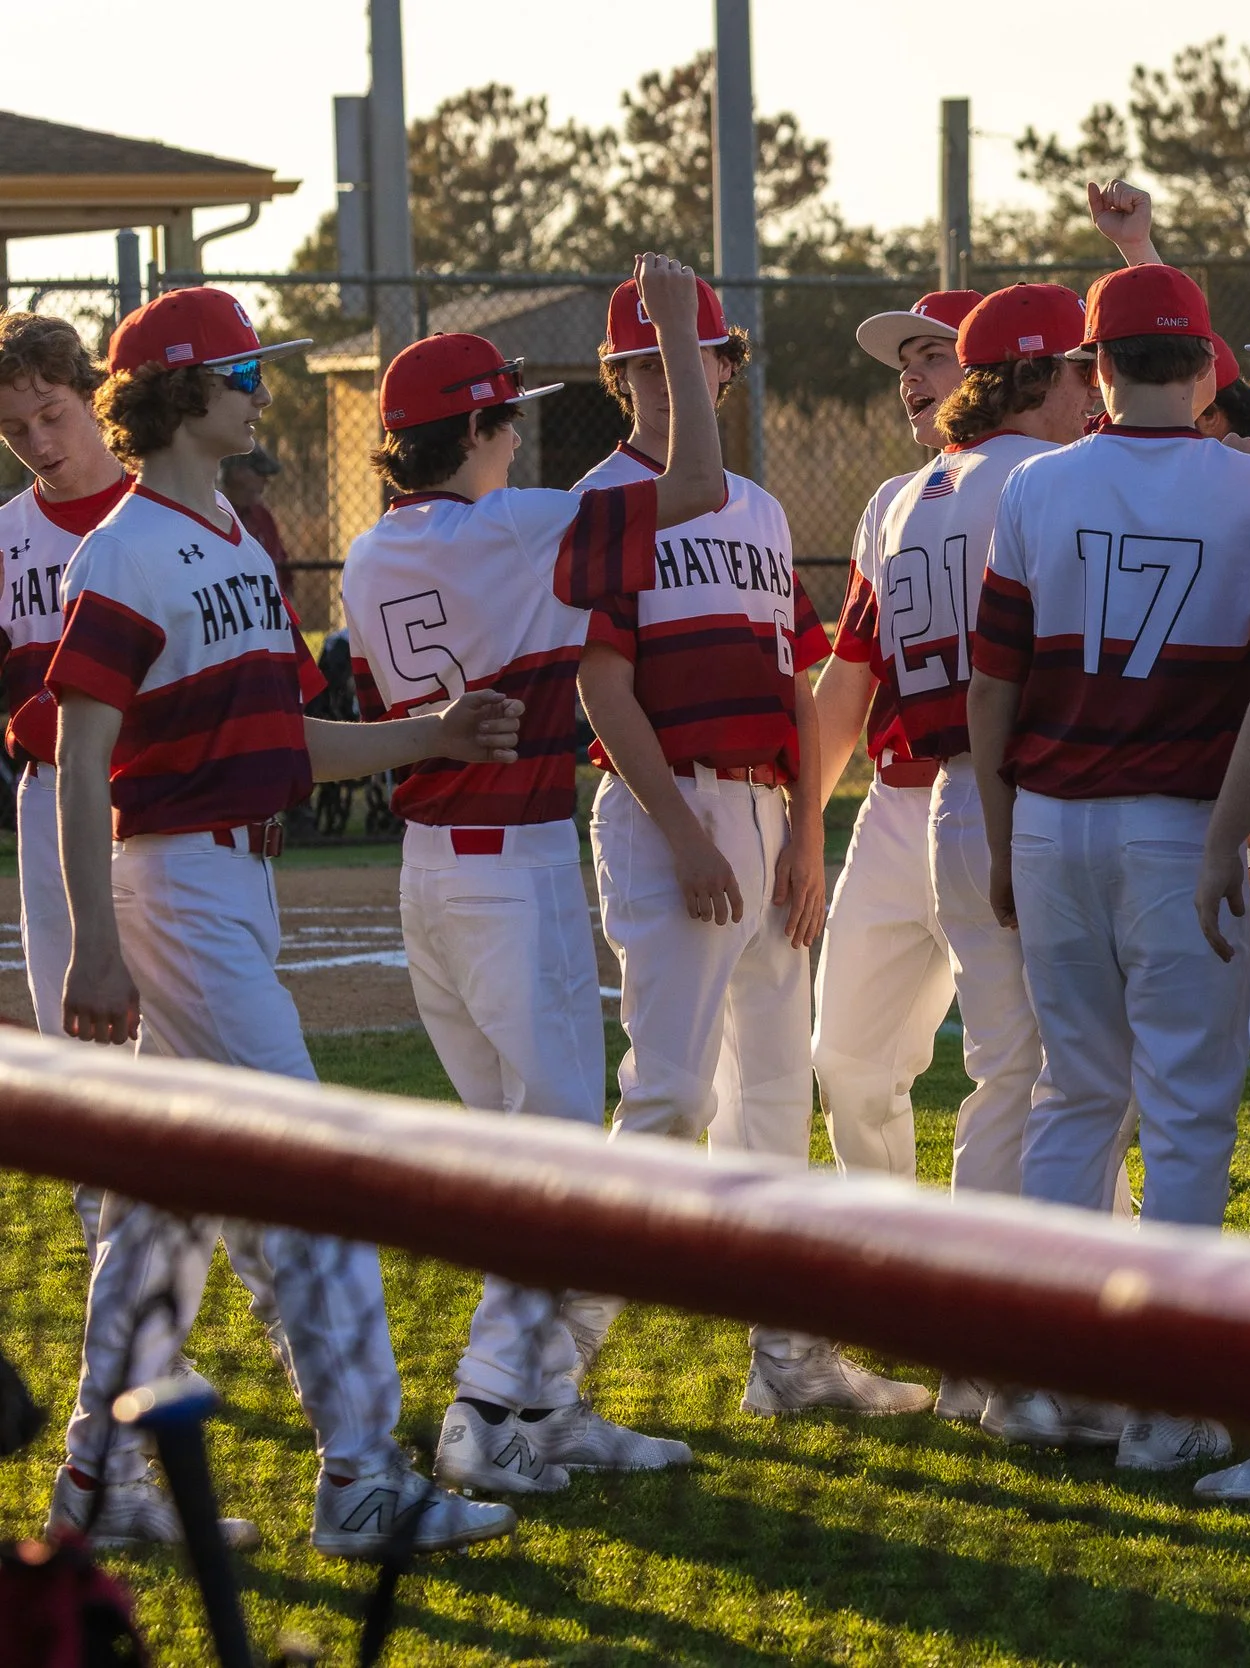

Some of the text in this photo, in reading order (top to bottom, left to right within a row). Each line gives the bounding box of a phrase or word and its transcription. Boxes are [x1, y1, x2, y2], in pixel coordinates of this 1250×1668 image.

[1156, 316, 1189, 327] CANES
[11, 562, 68, 622] HAT
[655, 537, 792, 599] HATTERAS
[1077, 529, 1204, 679] 17
[192, 572, 289, 646] HATR
[773, 608, 795, 678] 6
[887, 533, 972, 697] 21
[380, 589, 467, 717] 5
